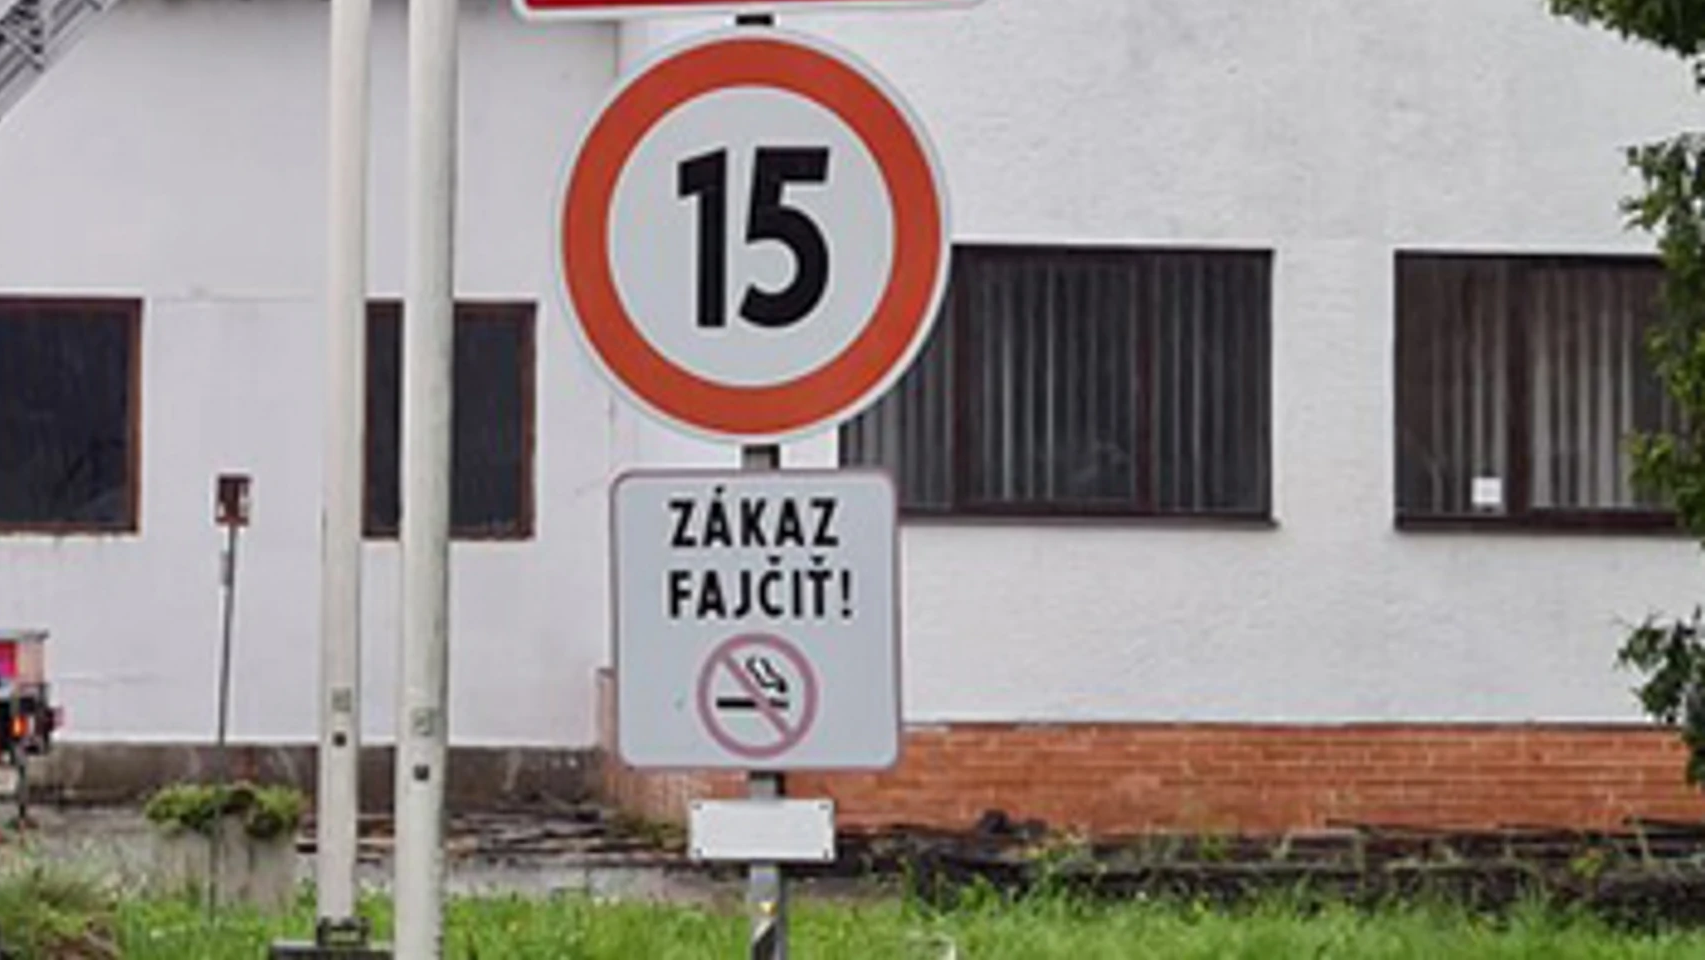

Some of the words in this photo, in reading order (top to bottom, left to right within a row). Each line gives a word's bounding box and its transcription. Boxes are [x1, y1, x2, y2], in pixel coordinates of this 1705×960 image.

[677, 146, 830, 328] 15
[668, 486, 840, 548] ZÁKAZ
[668, 555, 854, 619] FAJČIŤ!
